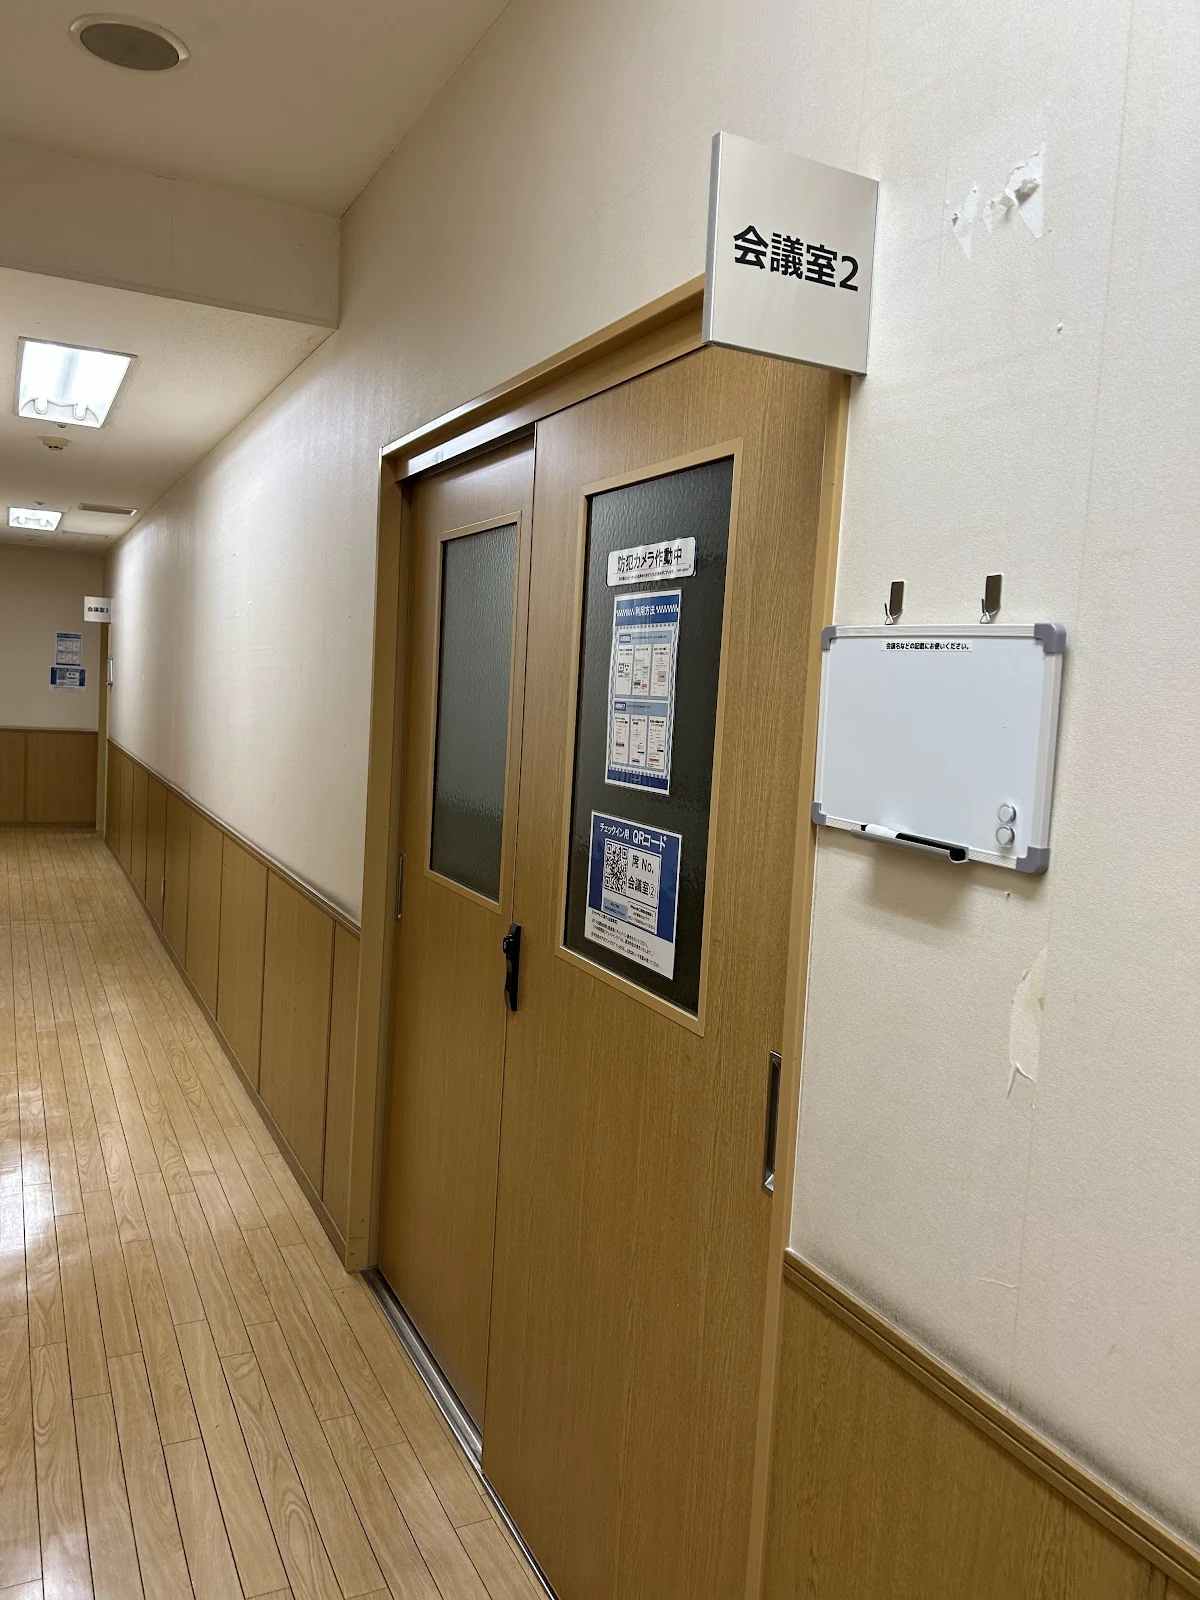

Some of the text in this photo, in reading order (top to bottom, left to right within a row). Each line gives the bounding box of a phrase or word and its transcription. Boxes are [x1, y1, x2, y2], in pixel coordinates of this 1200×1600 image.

[733, 225, 859, 292] 会議室2
[618, 545, 682, 572] 防犯カメラ作動中
[635, 605, 656, 617] 利用方法
[632, 829, 668, 851] QRコード
[632, 854, 654, 874] 席 No.
[628, 875, 656, 898] 会議室②
